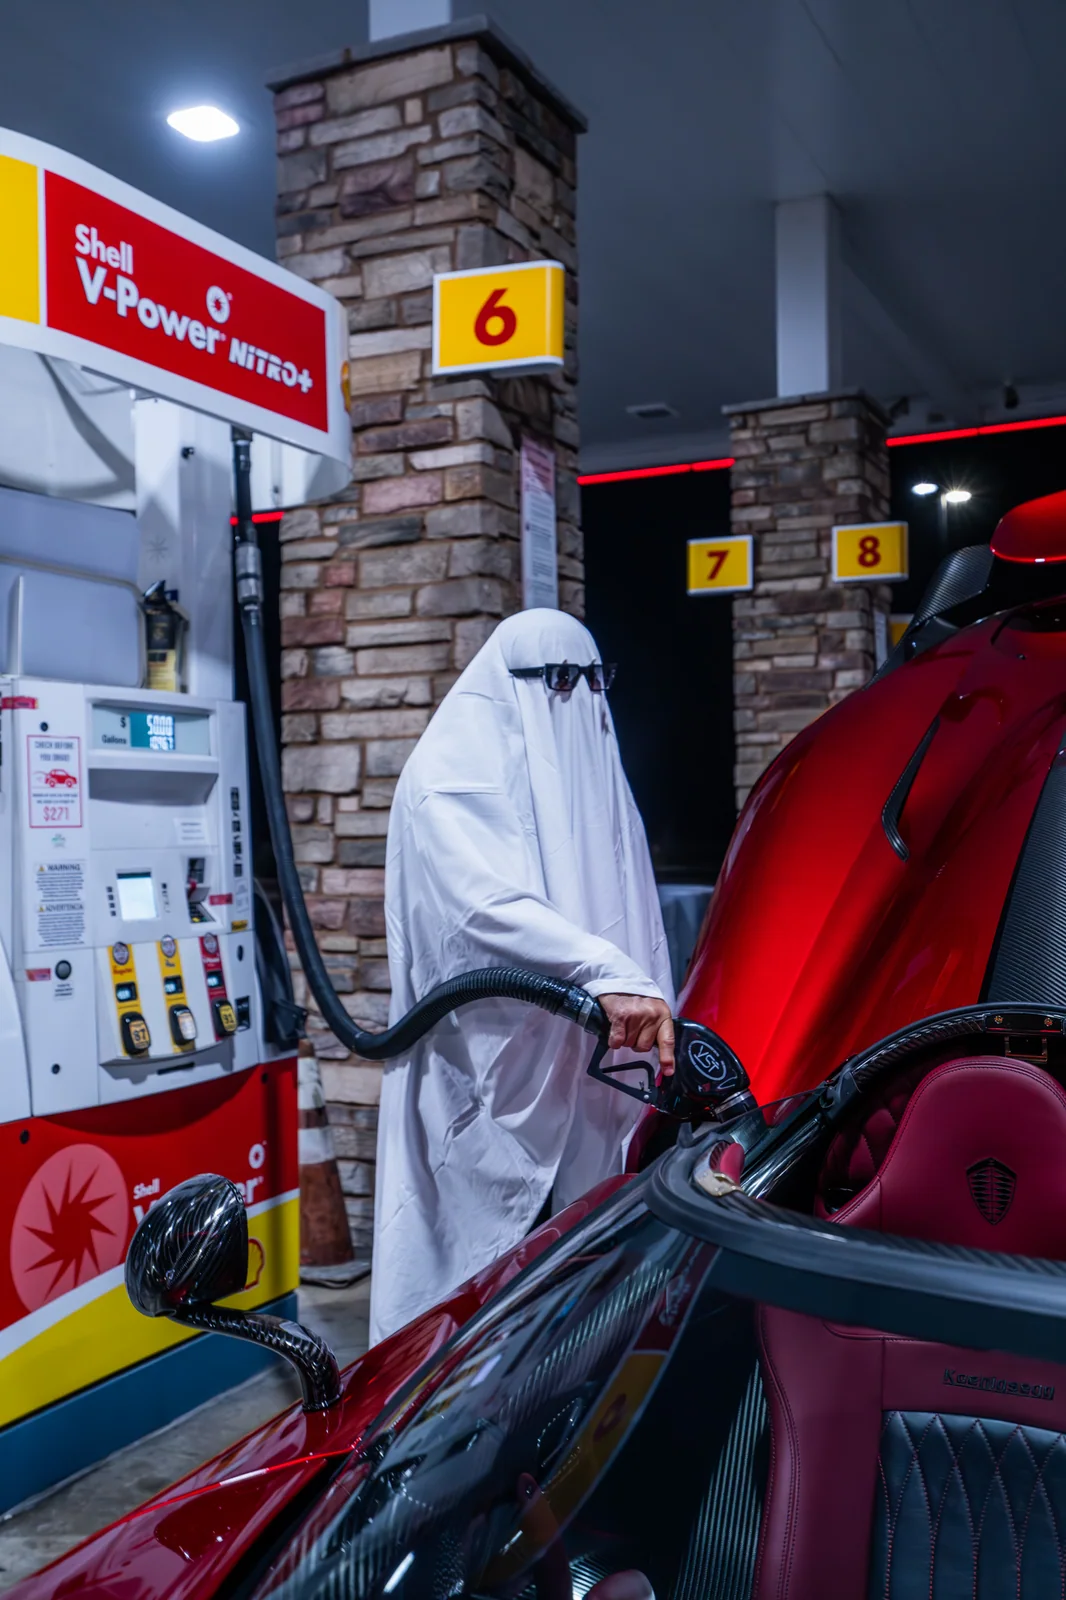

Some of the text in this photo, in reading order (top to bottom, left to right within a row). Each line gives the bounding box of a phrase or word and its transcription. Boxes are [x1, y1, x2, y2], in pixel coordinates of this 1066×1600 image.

[75, 223, 133, 275] Shell
[75, 256, 221, 355] V-Power
[474, 287, 517, 347] 6
[707, 549, 730, 581] 7
[857, 535, 882, 568] 8
[119, 716, 127, 728] $
[102, 734, 127, 745] Gallons
[47, 863, 81, 871] WARNING
[133, 1178, 160, 1201] Shell
